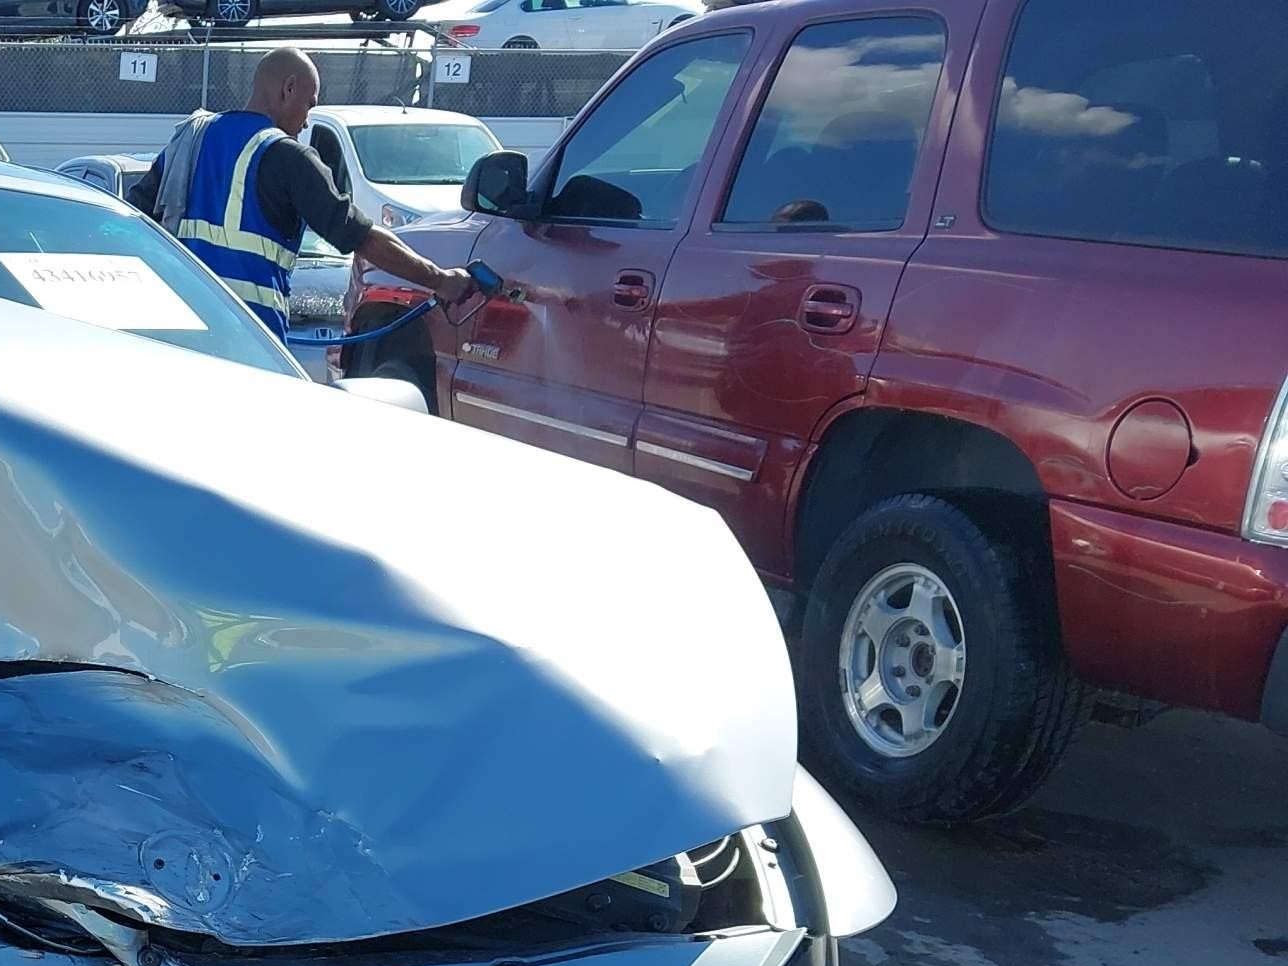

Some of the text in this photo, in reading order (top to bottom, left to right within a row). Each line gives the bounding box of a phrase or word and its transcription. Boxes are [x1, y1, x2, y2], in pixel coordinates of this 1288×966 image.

[131, 60, 146, 74] 11
[445, 62, 461, 76] 12
[935, 216, 954, 227] LT
